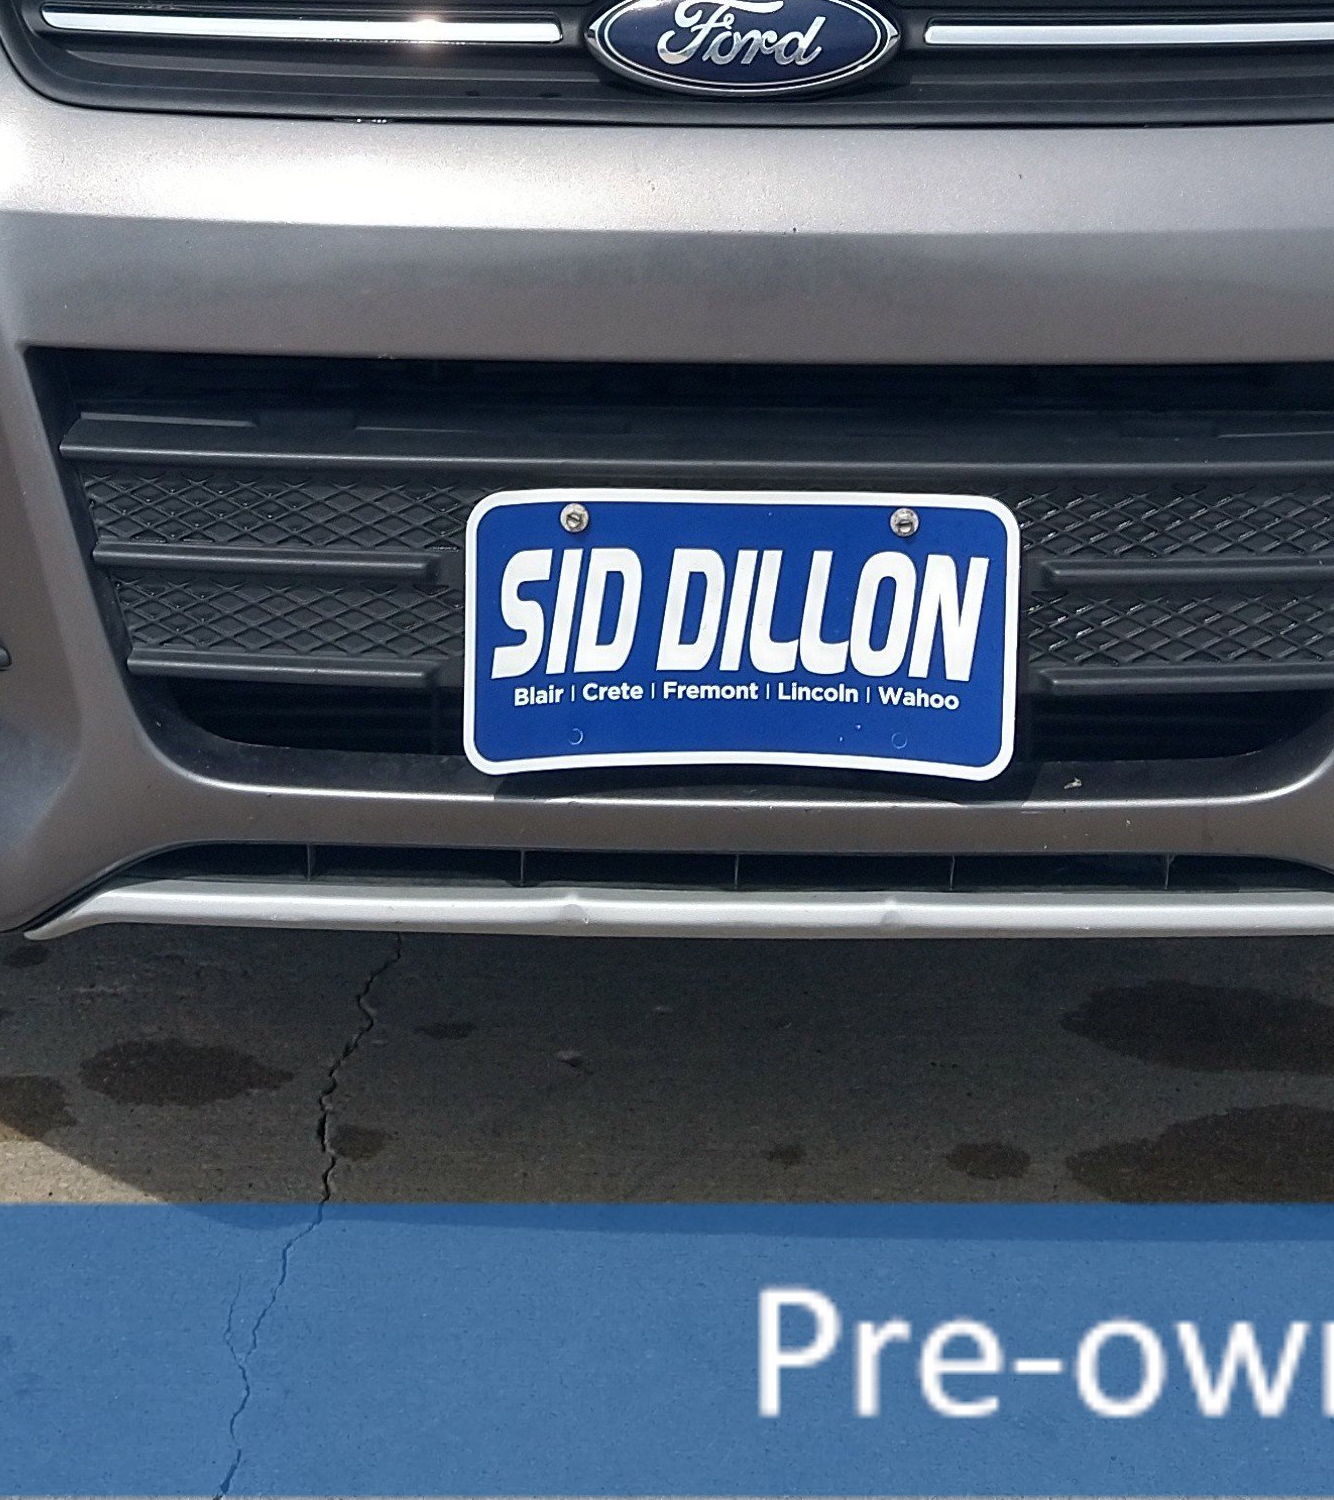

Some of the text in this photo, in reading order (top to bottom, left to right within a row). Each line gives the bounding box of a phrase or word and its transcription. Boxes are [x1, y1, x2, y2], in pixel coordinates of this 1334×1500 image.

[491, 547, 990, 682] SID DILLON
[513, 680, 960, 711] Blair Crete Fremont Lincoln Wahoo
